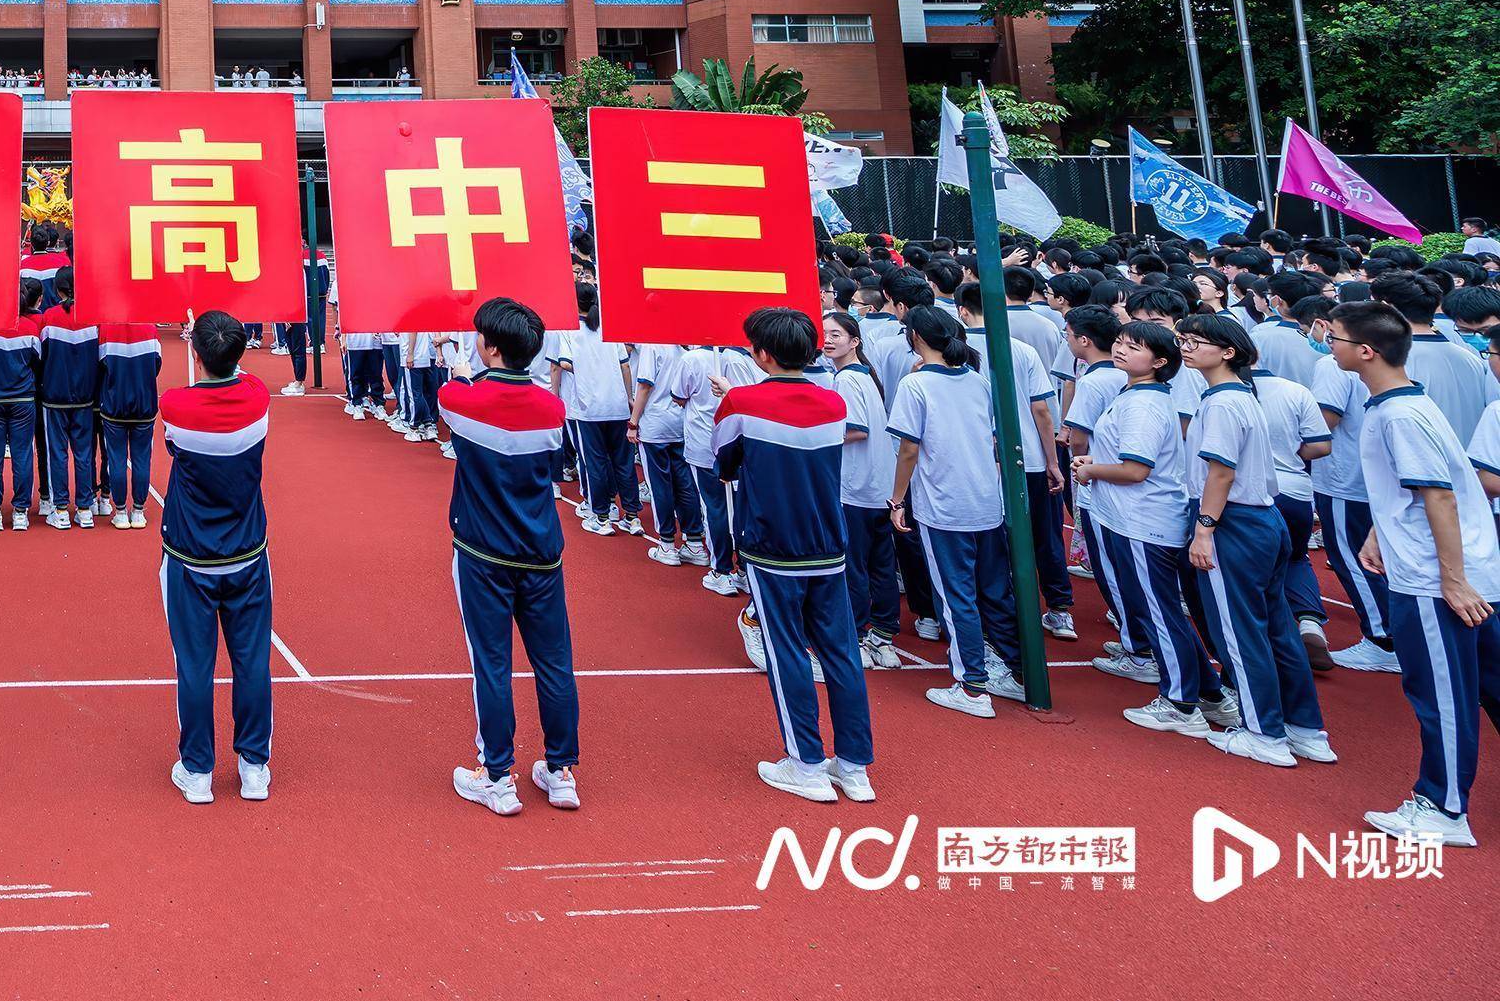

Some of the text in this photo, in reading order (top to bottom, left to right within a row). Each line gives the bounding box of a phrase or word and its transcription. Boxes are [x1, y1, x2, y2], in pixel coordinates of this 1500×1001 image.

[119, 128, 263, 282] 高
[384, 137, 530, 291] 中
[642, 161, 787, 294] 三
[1160, 181, 1191, 211] 11
